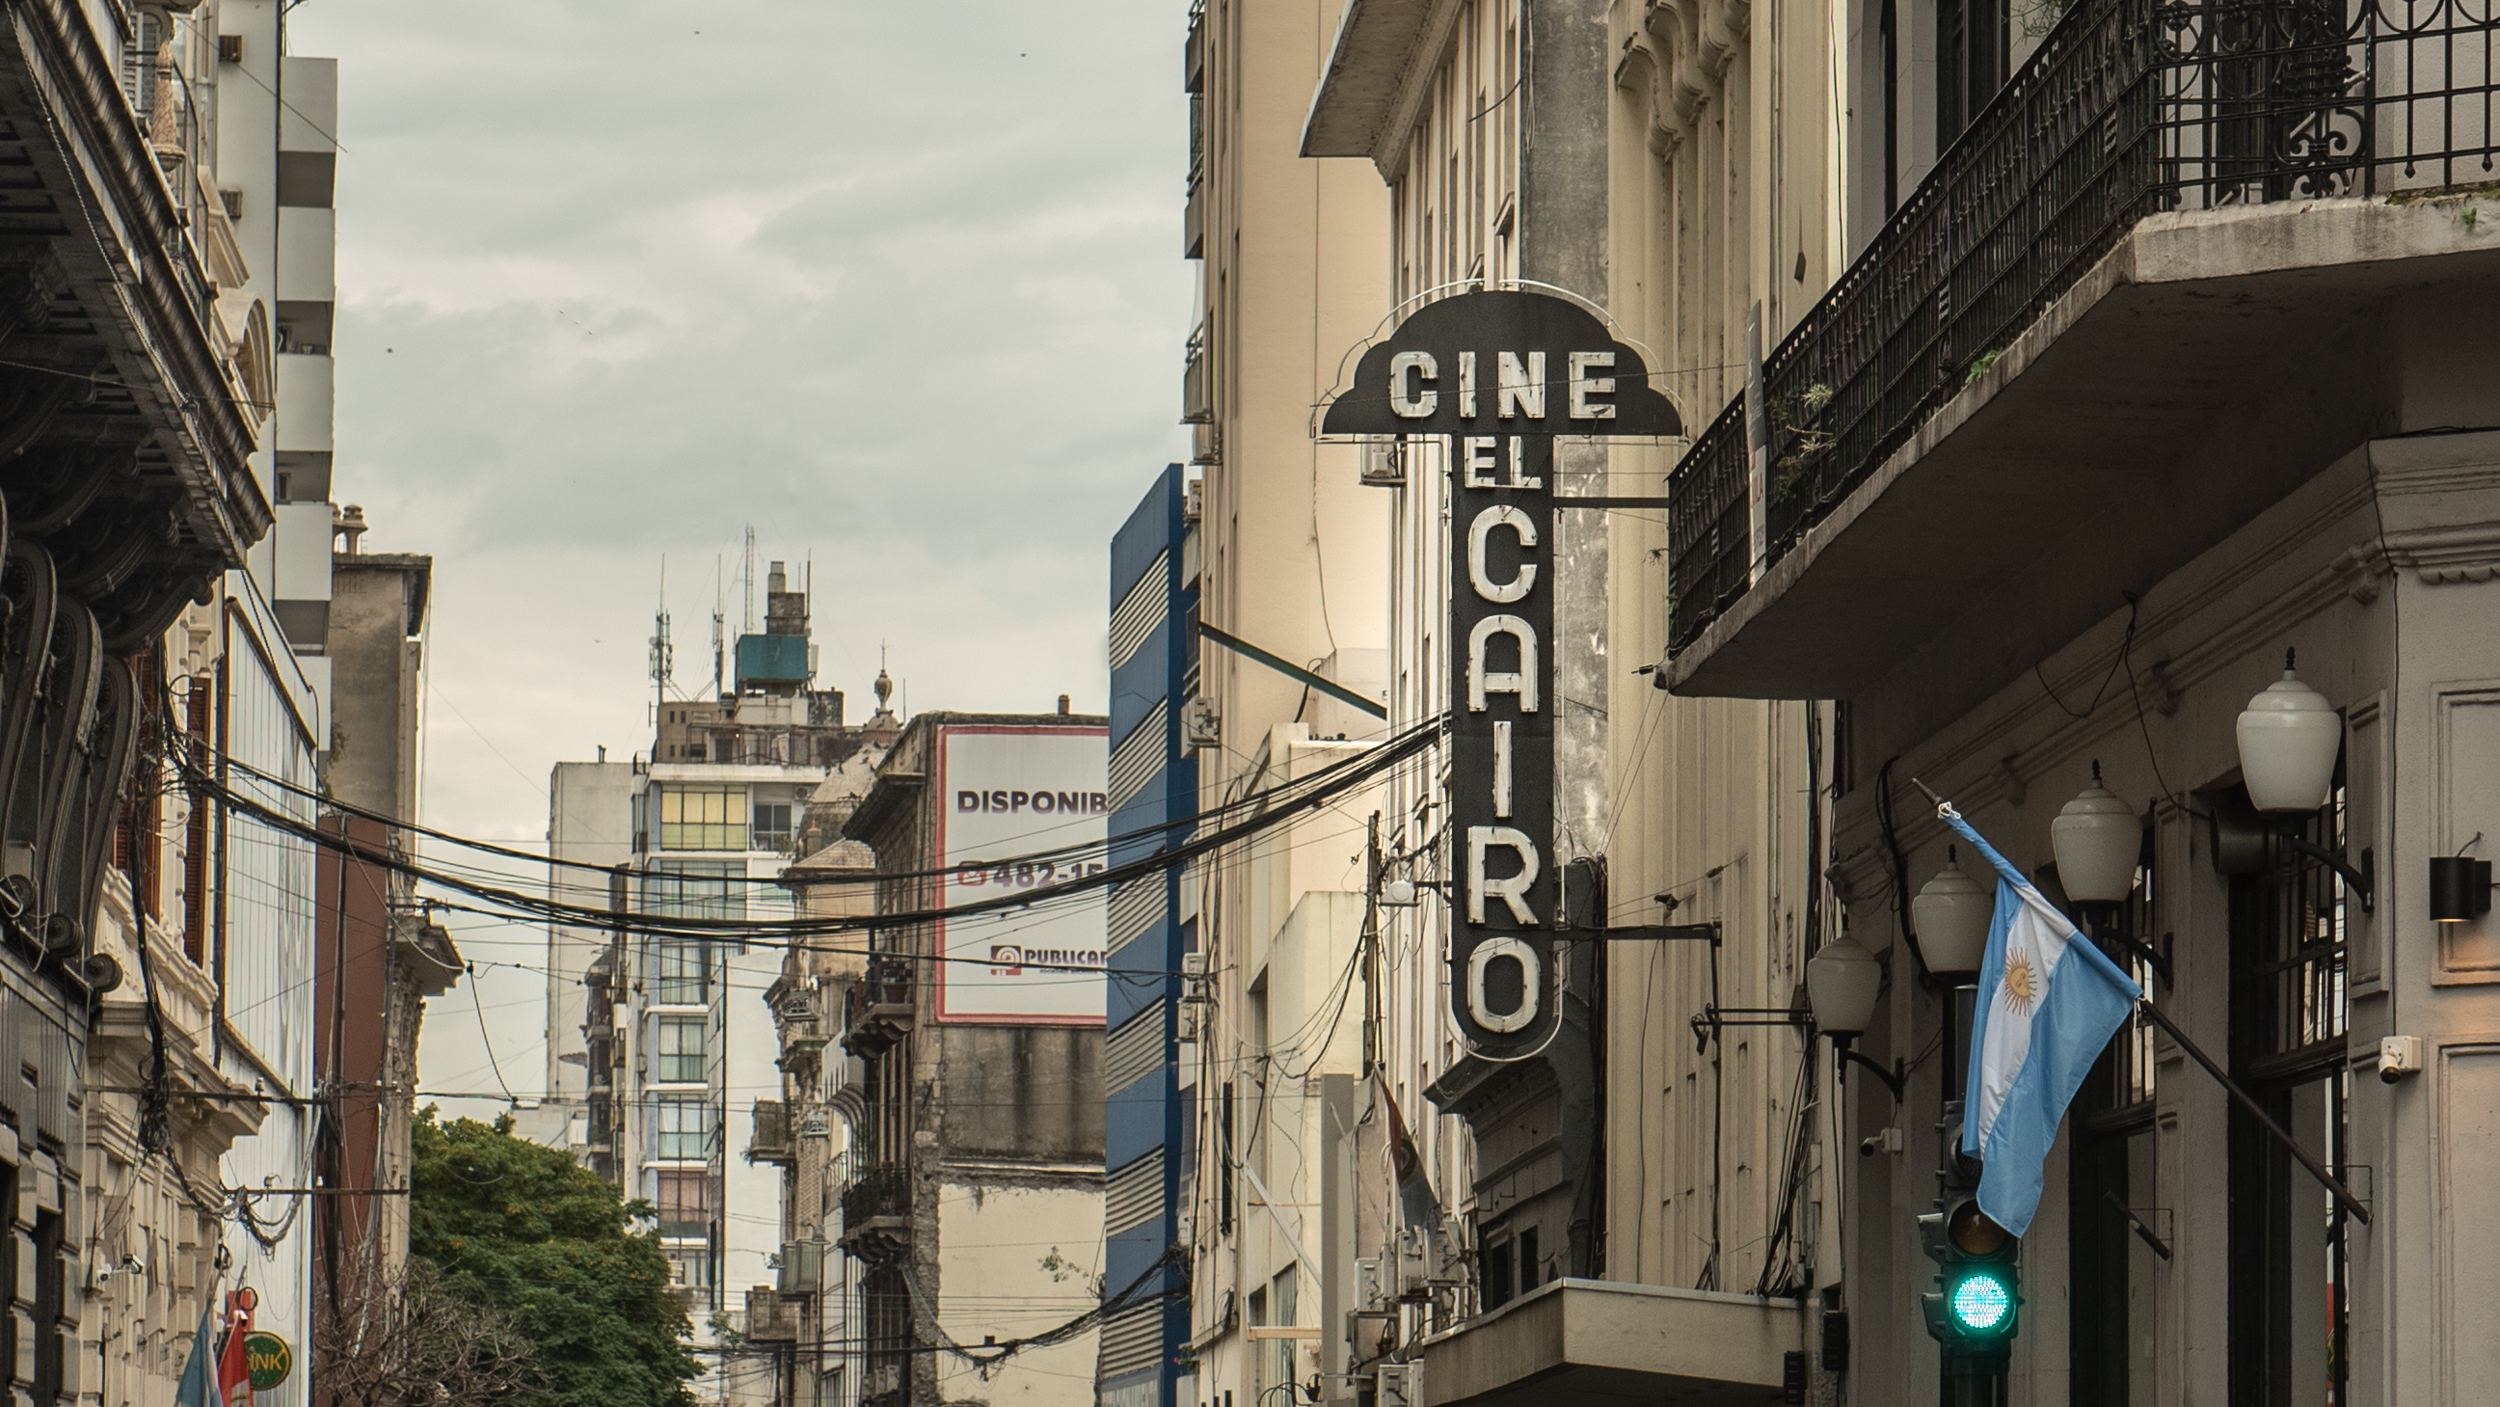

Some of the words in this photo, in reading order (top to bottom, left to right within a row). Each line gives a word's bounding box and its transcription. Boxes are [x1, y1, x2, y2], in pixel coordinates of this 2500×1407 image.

[1389, 351, 1616, 419] CINE
[1464, 435, 1543, 489] EL
[1466, 504, 1541, 1034] CAIRO
[958, 790, 1107, 815] DISPONIB
